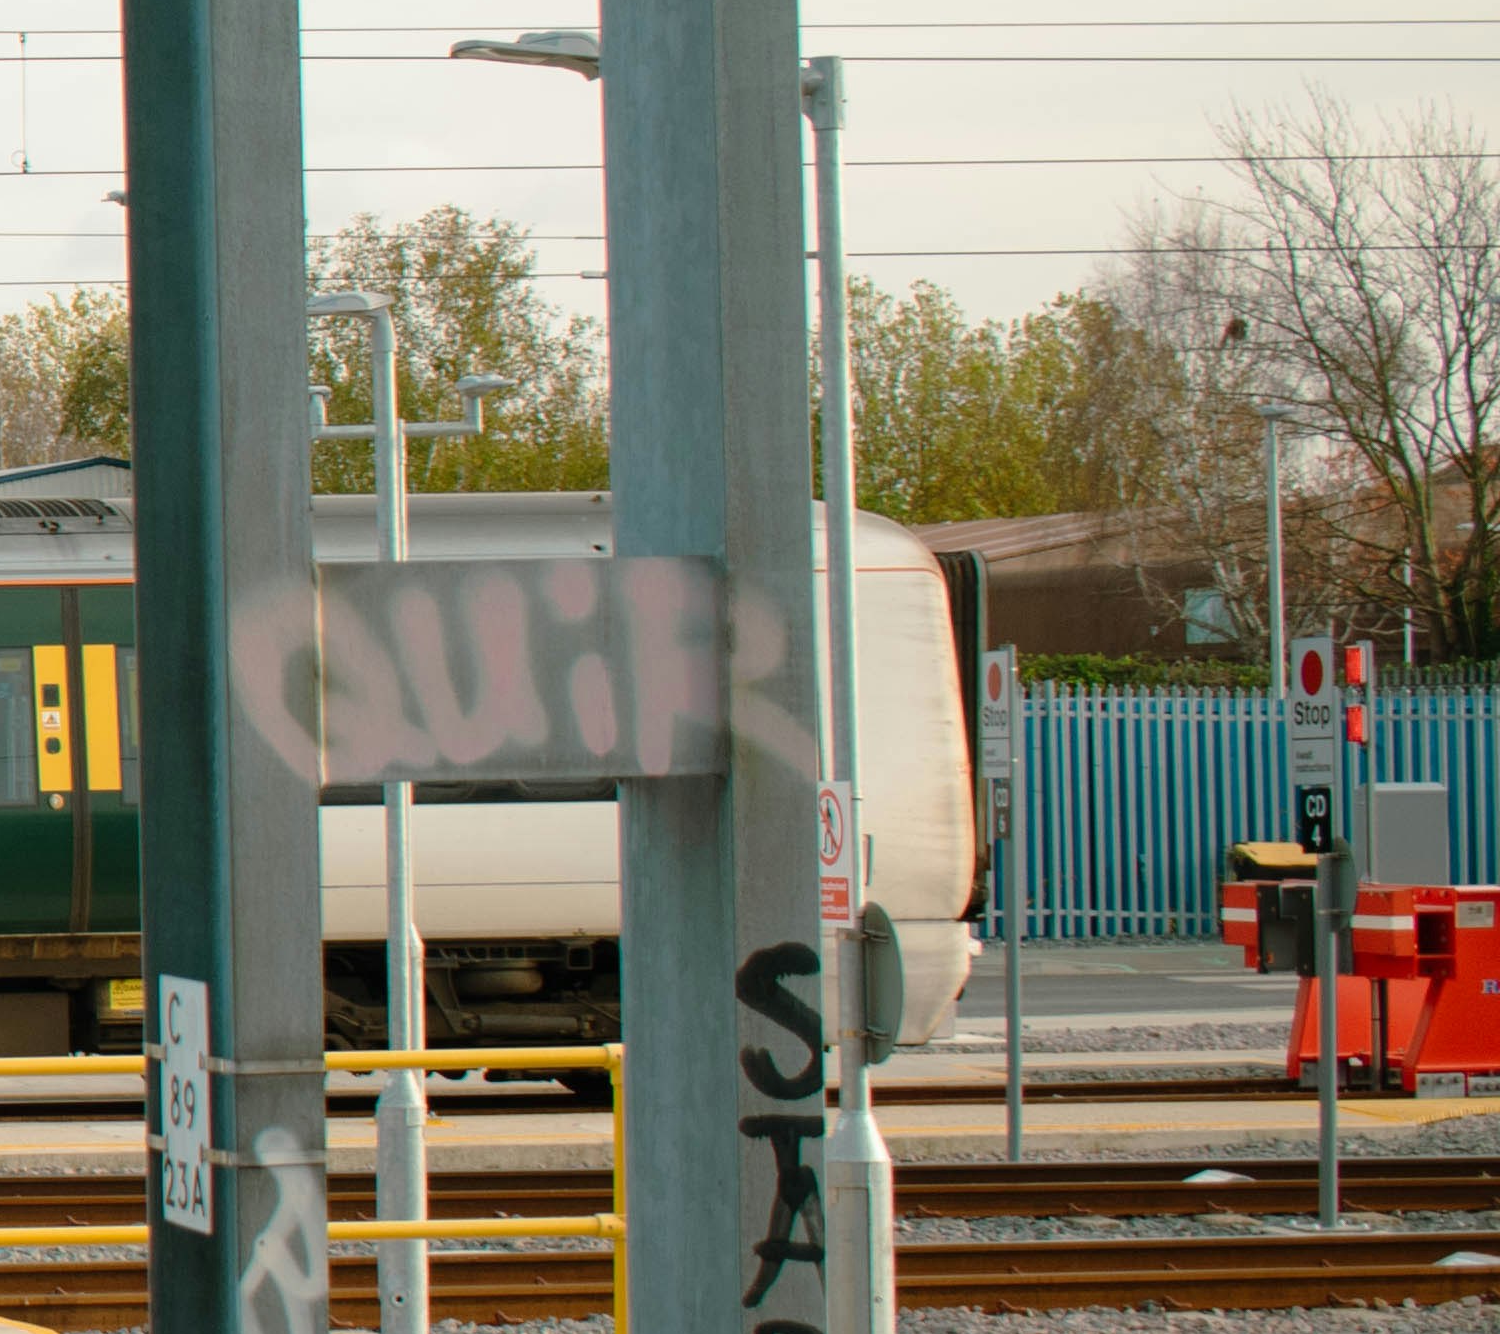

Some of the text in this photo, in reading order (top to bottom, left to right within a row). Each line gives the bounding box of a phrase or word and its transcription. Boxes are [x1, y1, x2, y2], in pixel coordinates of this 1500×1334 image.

[1294, 701, 1330, 729] Stop
[1306, 794, 1326, 817] CD
[1311, 823, 1321, 847] 4
[168, 991, 181, 1044] C
[170, 1075, 195, 1130] 89
[164, 1156, 206, 1218] 23A
